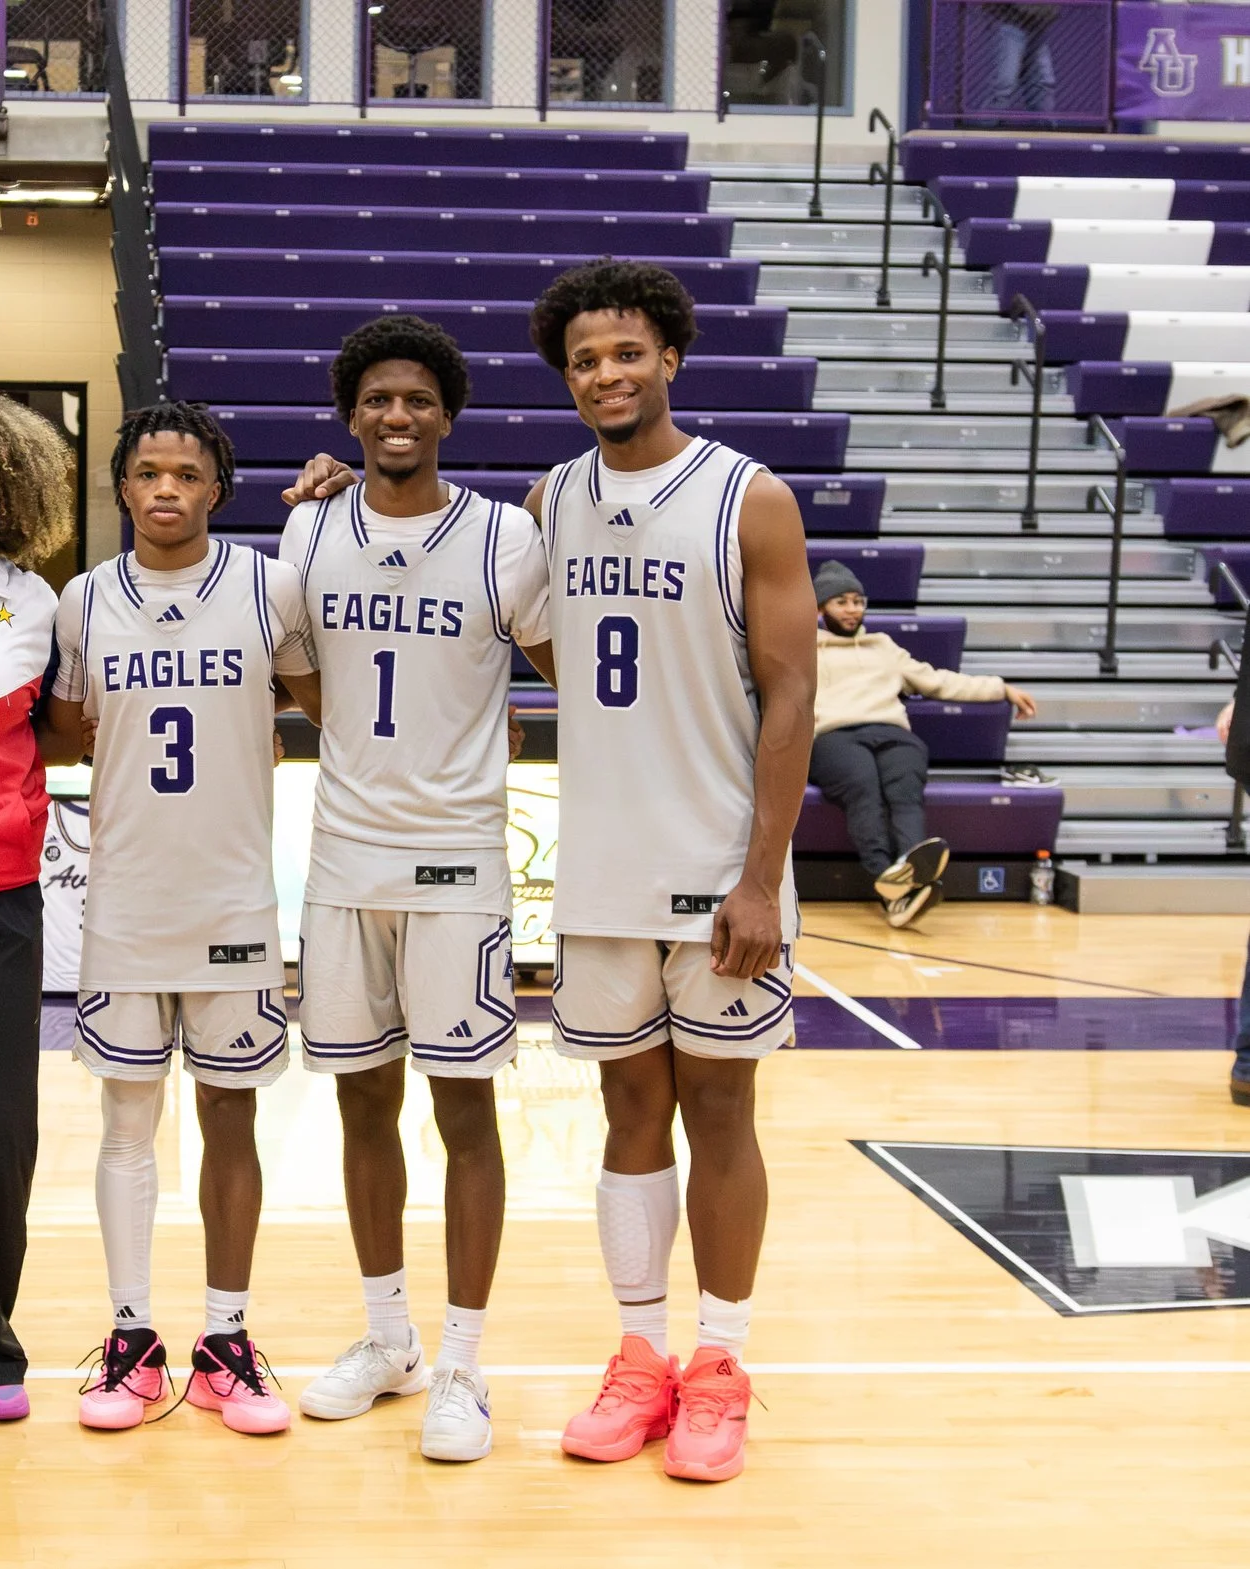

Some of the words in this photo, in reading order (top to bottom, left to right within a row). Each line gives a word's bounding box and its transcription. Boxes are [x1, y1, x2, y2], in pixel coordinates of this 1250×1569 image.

[566, 555, 686, 602] EAGLES
[321, 592, 464, 638] EAGLES
[102, 648, 244, 693] EAGLES
[372, 648, 397, 740] 1
[594, 613, 641, 710] 8
[148, 705, 196, 795] 3
